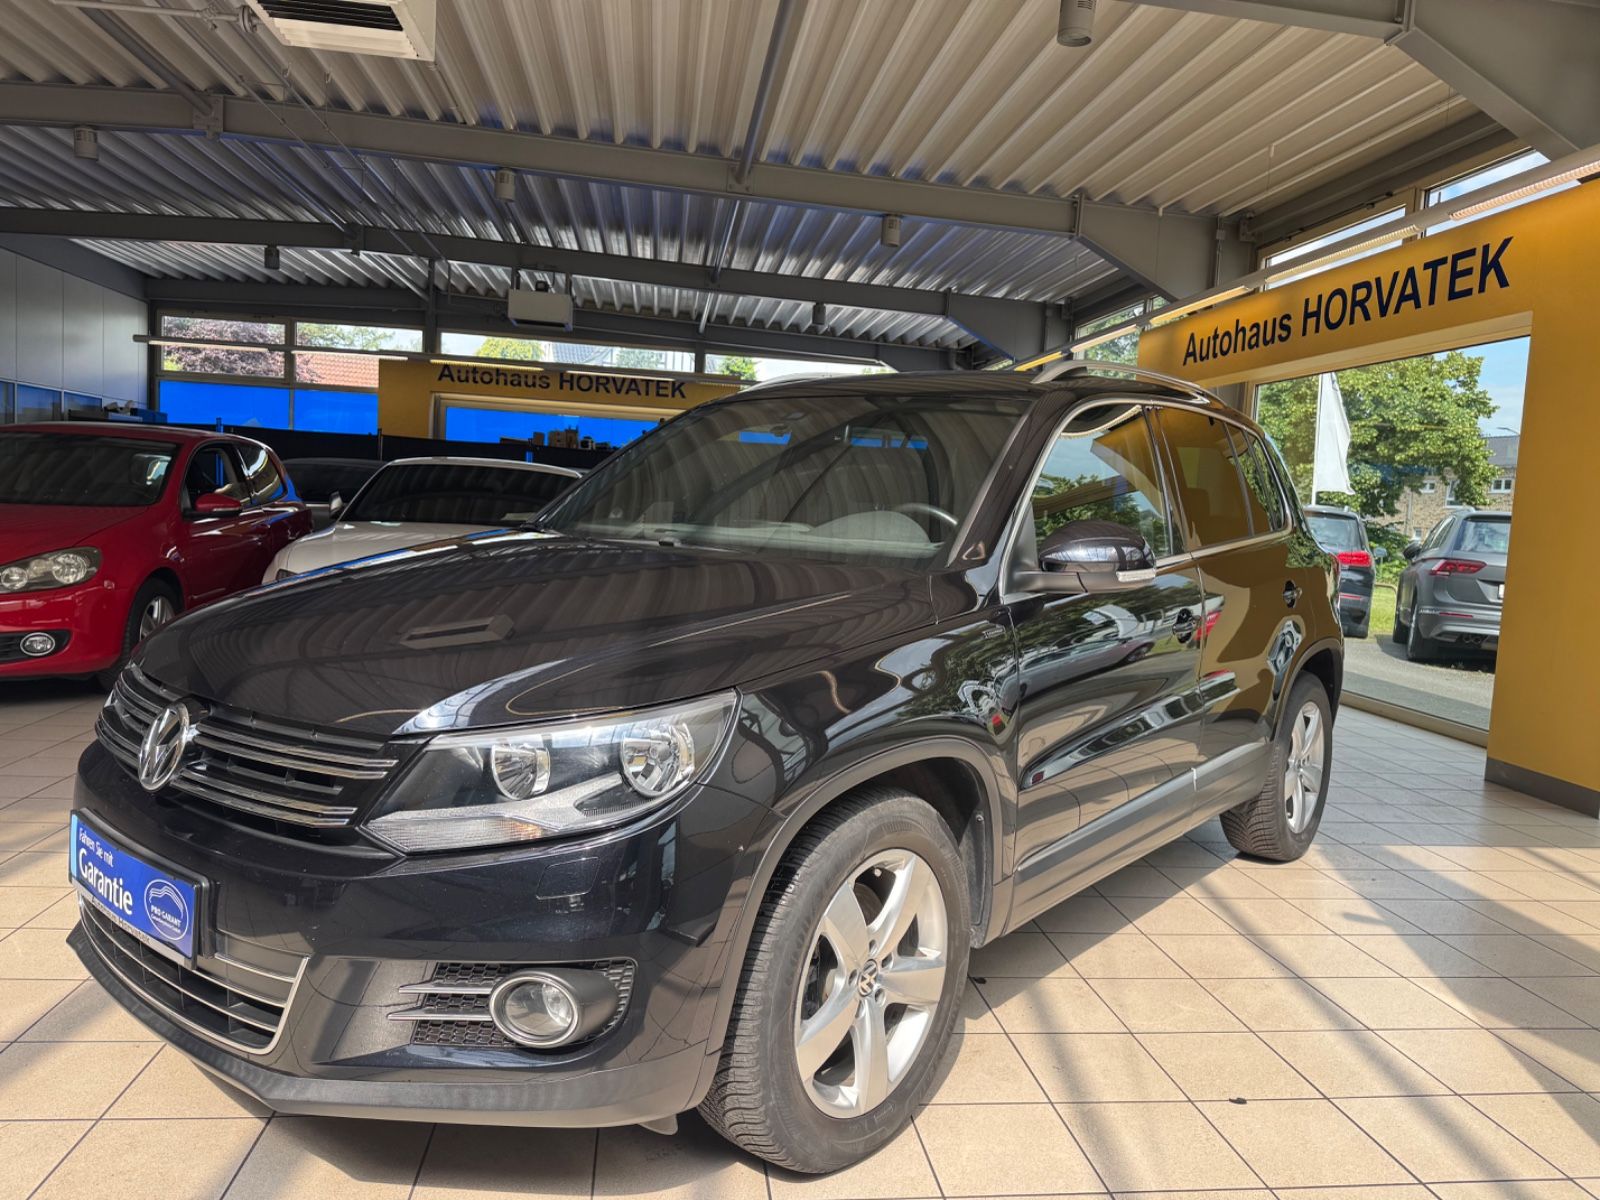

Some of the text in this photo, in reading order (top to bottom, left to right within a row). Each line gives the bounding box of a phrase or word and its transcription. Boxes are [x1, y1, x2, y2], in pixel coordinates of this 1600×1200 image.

[1183, 236, 1514, 366] Autohaus HORVATEK
[438, 365, 687, 399] Autohaus HORVATEK
[79, 847, 133, 915] Garantie
[103, 851, 113, 868] mit
